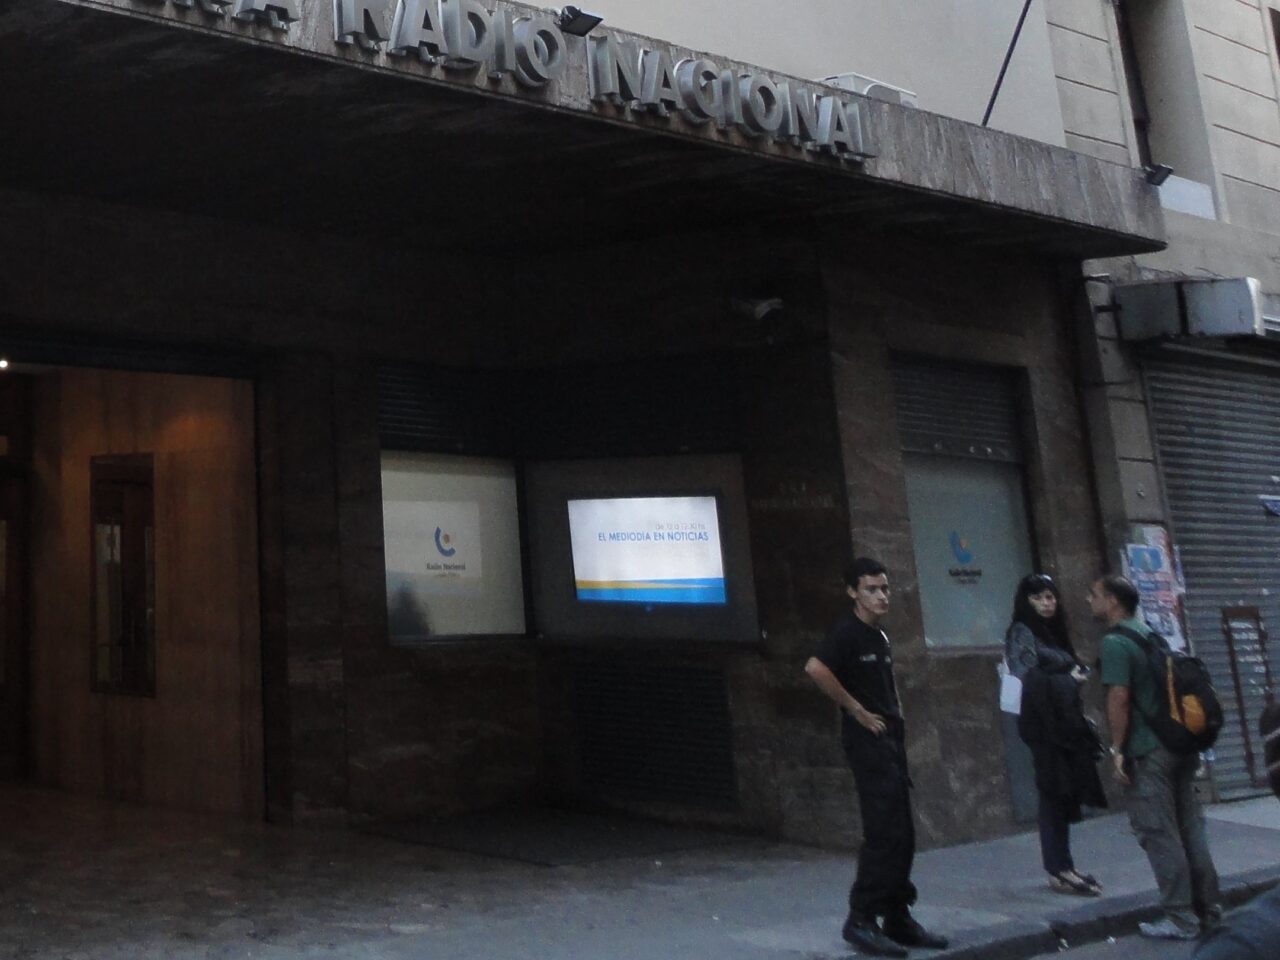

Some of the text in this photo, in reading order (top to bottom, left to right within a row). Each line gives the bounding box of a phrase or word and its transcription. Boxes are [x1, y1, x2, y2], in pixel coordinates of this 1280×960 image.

[586, 35, 878, 163] NACIONAL
[653, 532, 664, 540] EN
[667, 531, 709, 541] NOTICIAS
